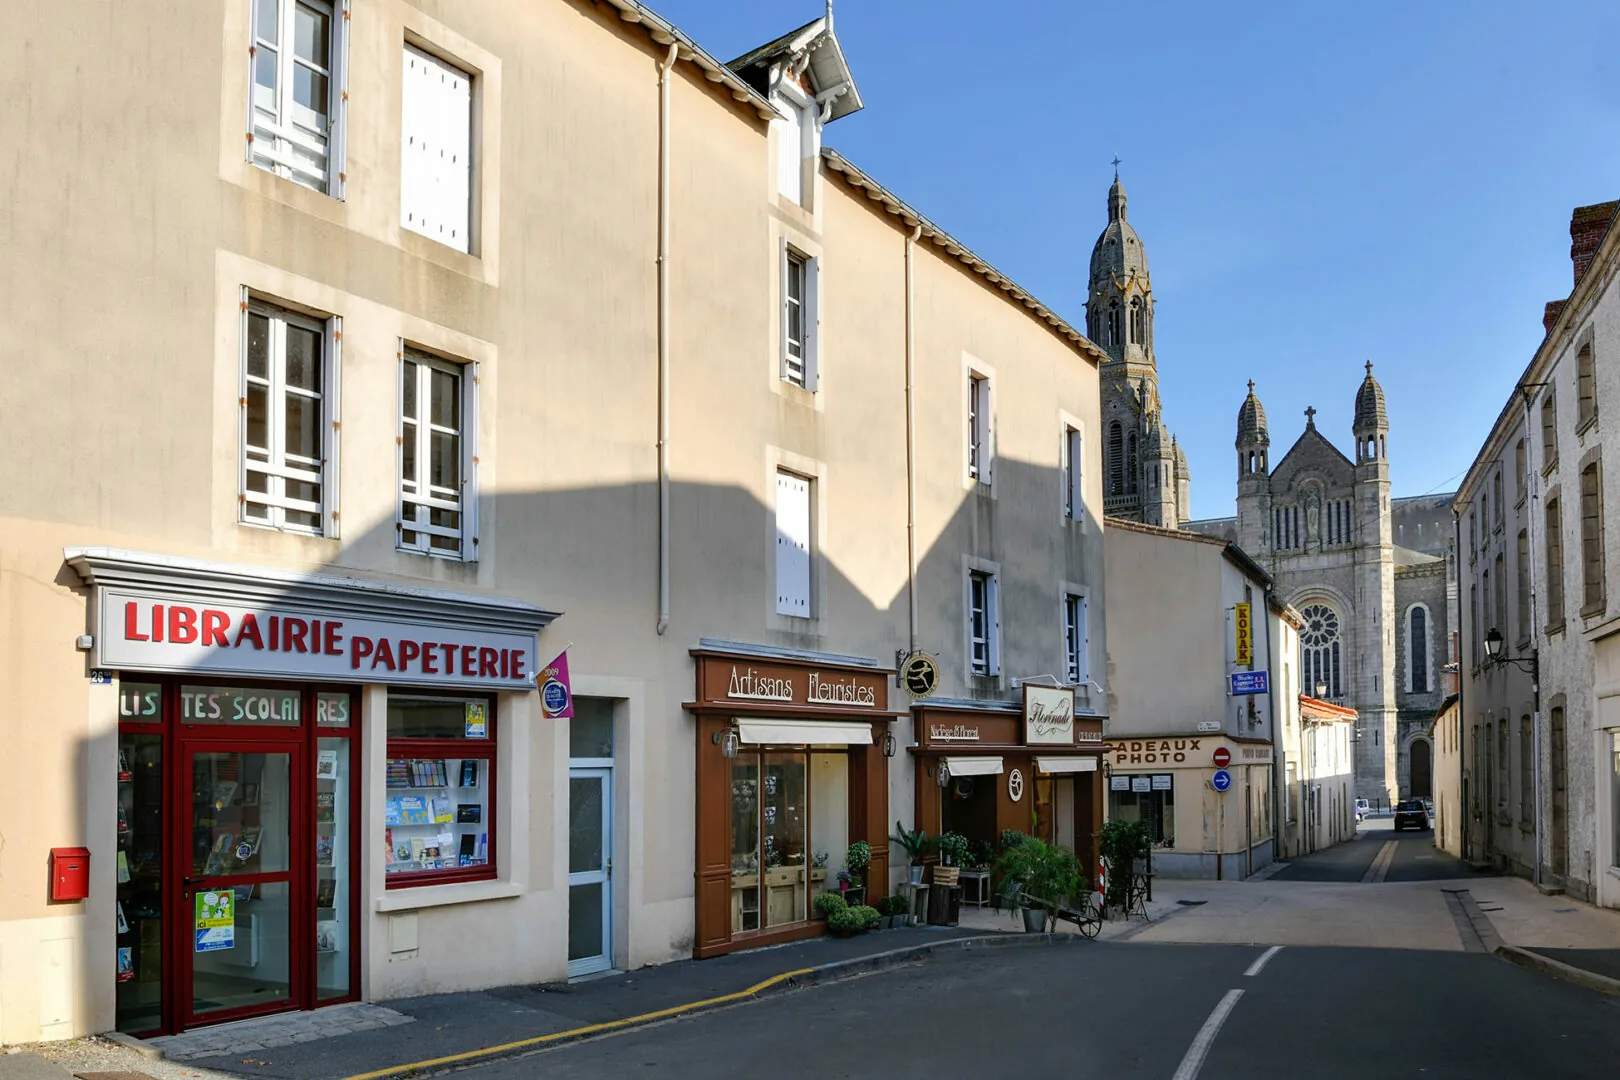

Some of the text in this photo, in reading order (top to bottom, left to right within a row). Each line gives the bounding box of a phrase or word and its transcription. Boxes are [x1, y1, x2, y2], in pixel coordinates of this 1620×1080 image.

[125, 601, 526, 679] LIBRAIRIE PAPETERIE
[1238, 608, 1248, 659] KODAK
[92, 671, 104, 683] 26
[728, 665, 875, 706] Artisans Fleuristes
[1116, 752, 1186, 764] PHOTO
